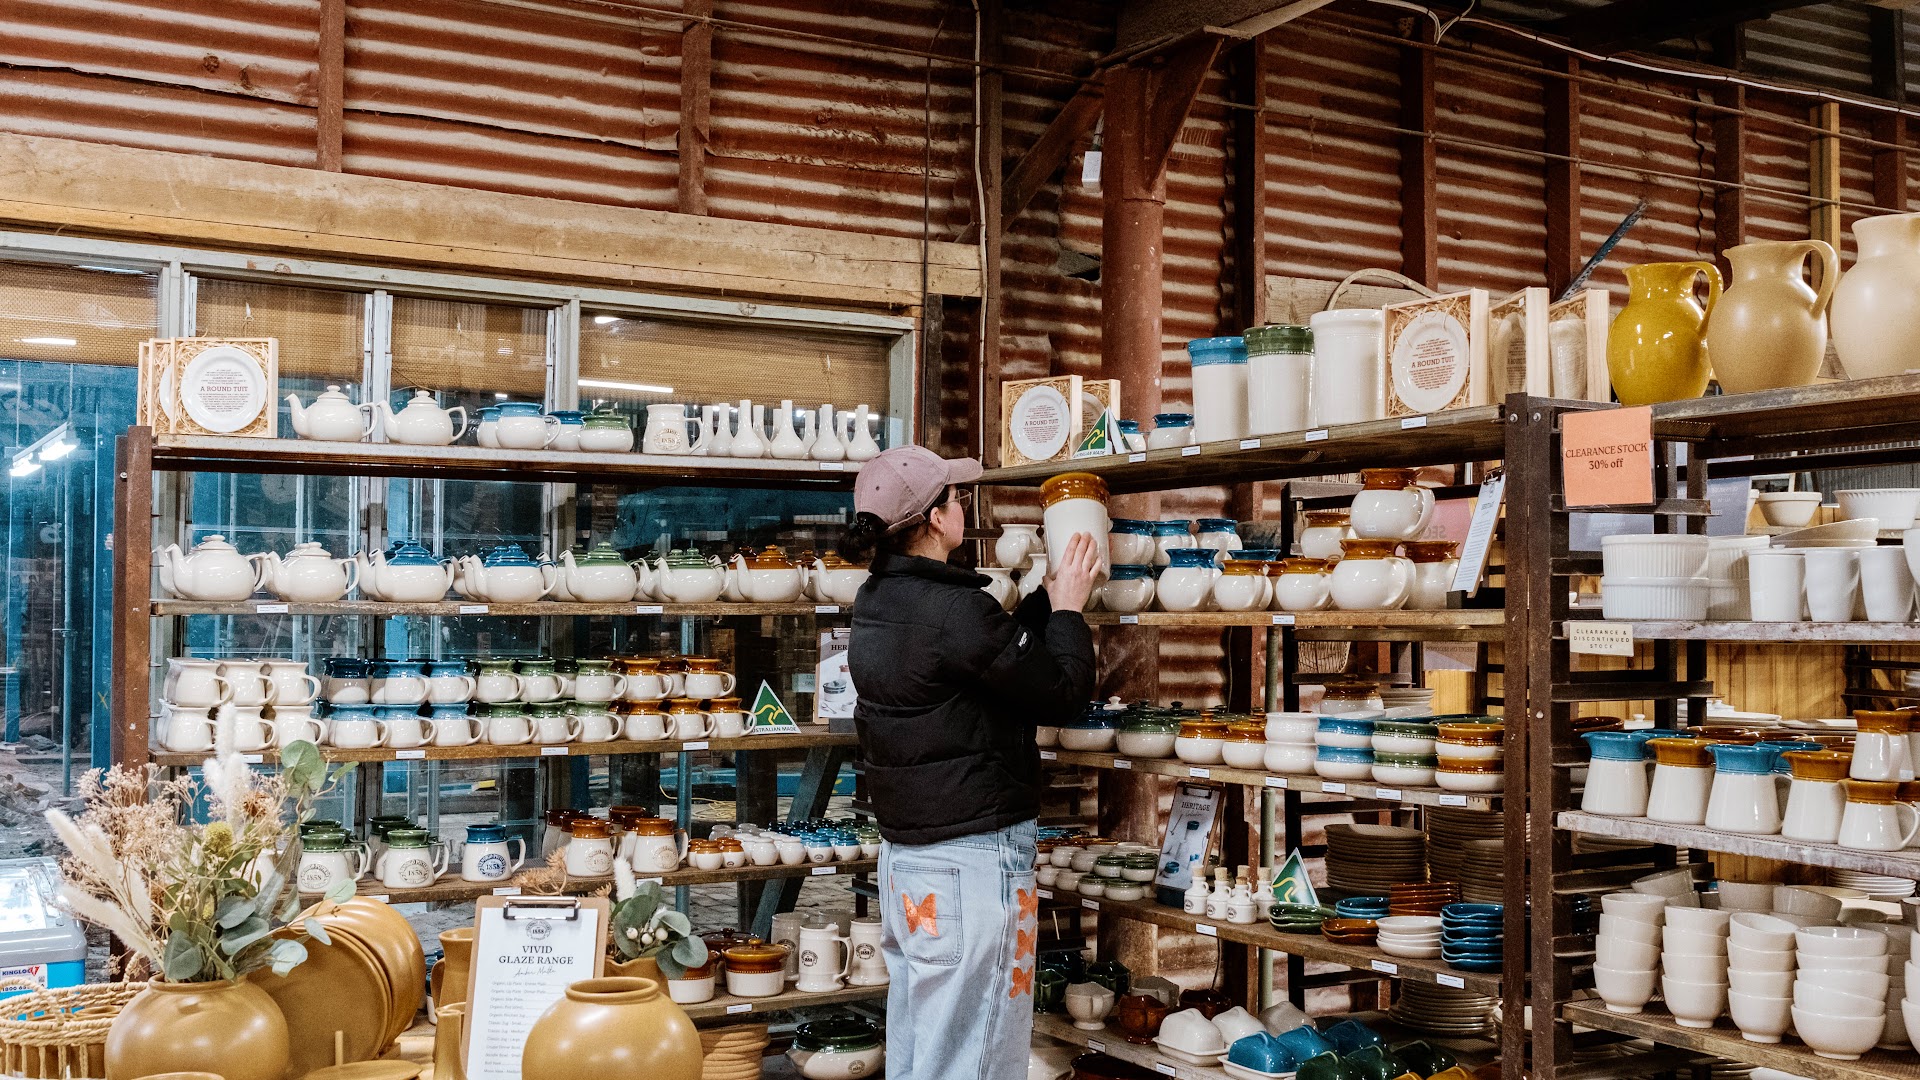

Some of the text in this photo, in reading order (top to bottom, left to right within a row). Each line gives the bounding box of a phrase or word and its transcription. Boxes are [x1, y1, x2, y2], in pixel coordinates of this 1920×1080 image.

[1417, 359, 1440, 367] ROUND
[1441, 356, 1455, 364] TUIT
[1565, 442, 1648, 458] CLEARANCE STOCK
[1588, 458, 1624, 470] 30% off
[1181, 801, 1211, 811] HERITAGE
[522, 945, 553, 954] VIVID
[498, 955, 574, 965] GLAZE RANGE
